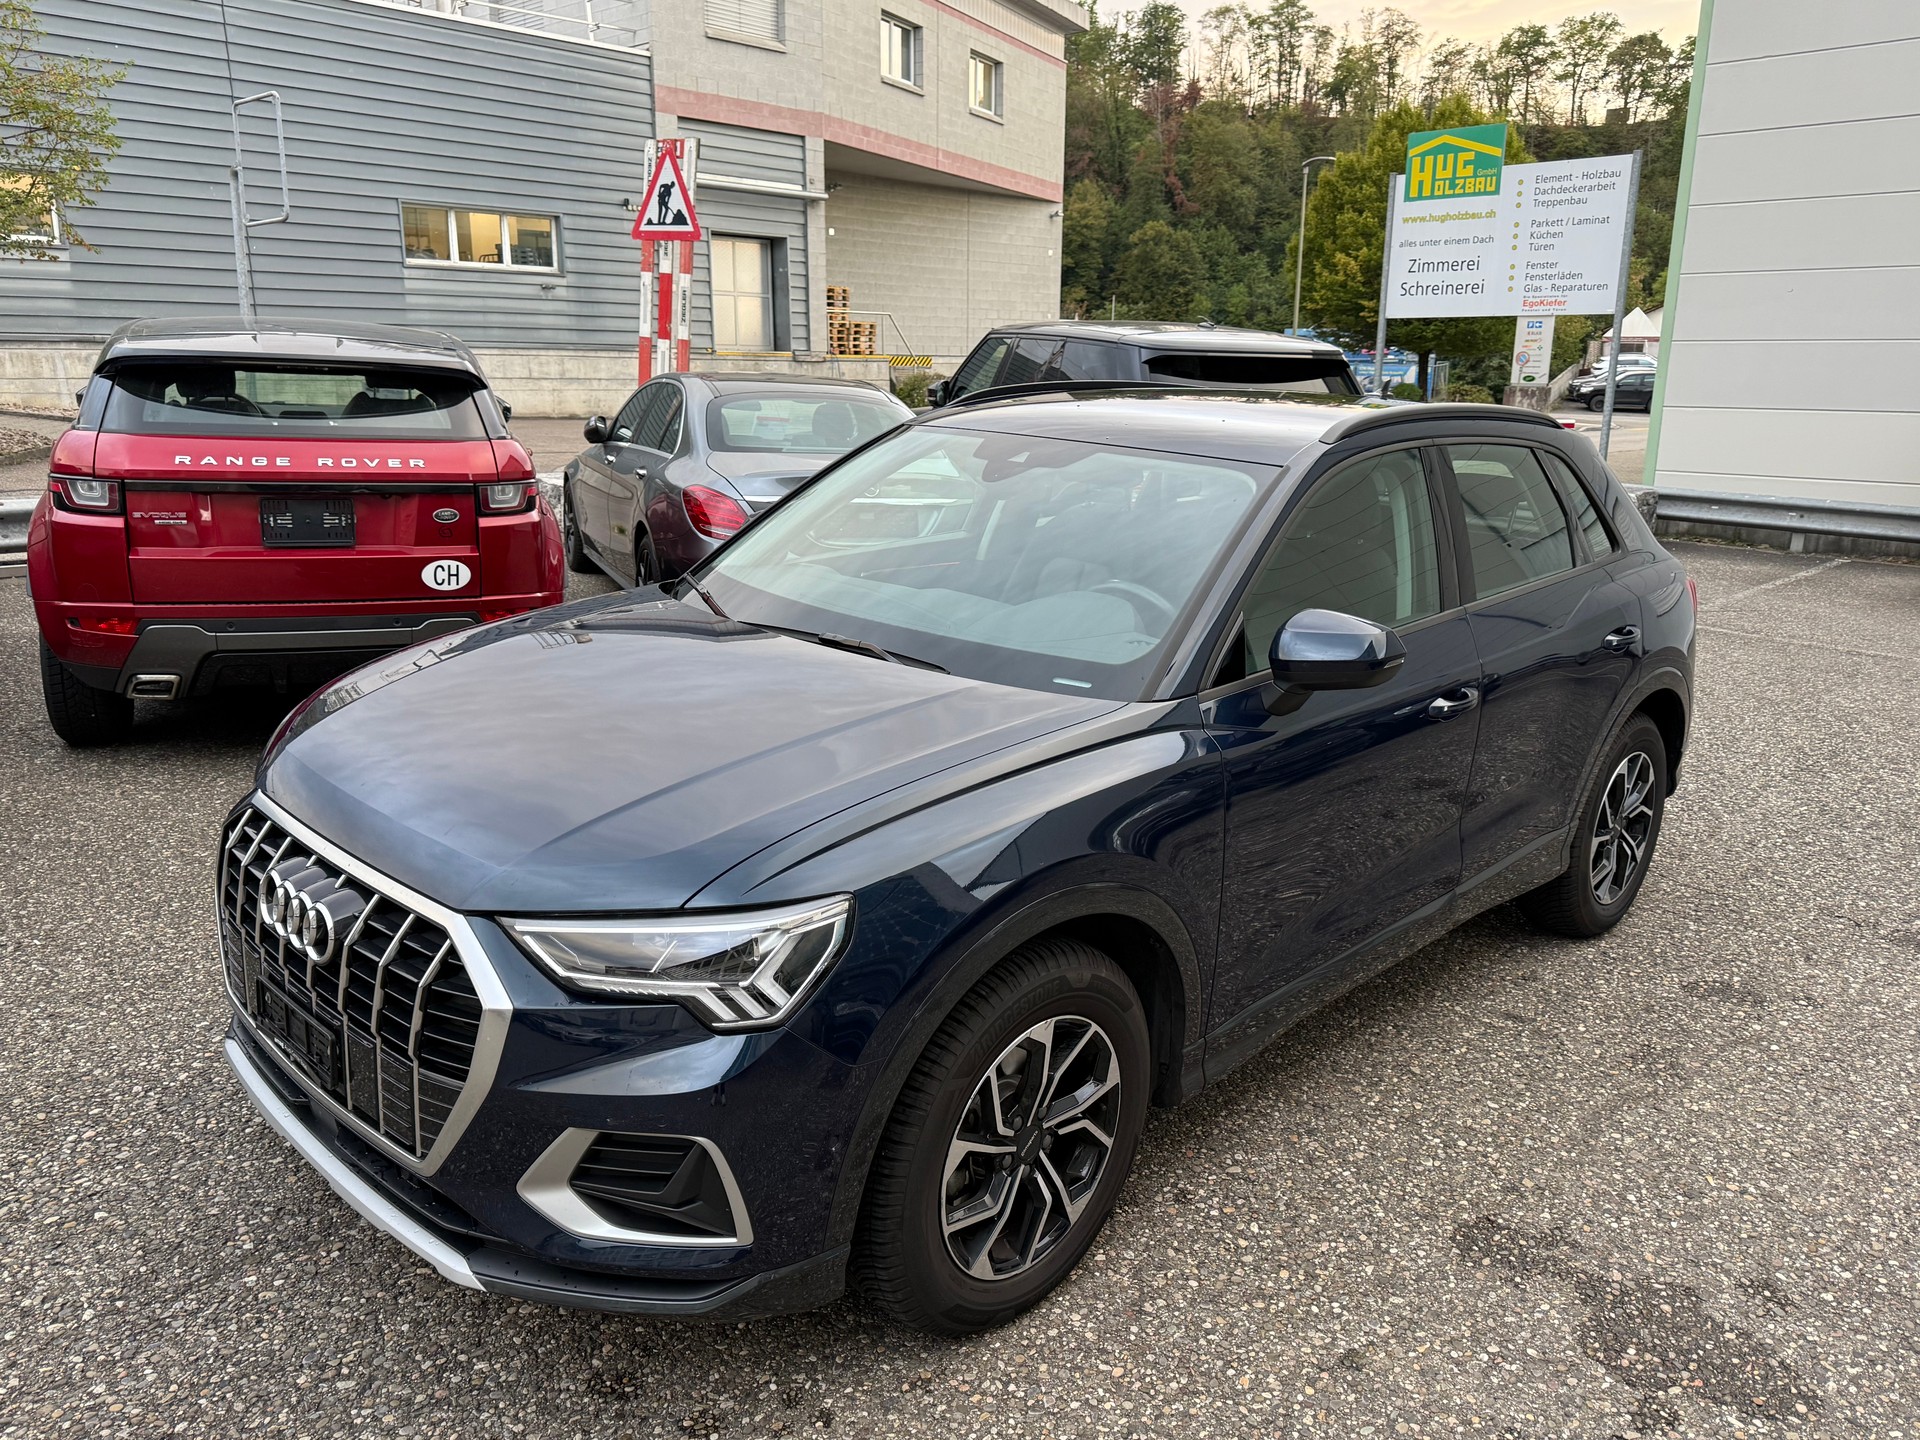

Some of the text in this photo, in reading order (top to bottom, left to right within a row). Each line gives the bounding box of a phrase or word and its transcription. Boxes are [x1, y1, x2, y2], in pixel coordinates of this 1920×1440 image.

[1476, 167, 1497, 176] GmbH
[1535, 173, 1573, 184] Element
[1581, 169, 1621, 180] Holzbau
[1534, 181, 1616, 196] Dachdeckerarbeit
[1533, 196, 1588, 208] Treppenbau
[1402, 209, 1496, 224] www.hugholzbau.ch
[1530, 218, 1564, 228] Parkett
[1571, 216, 1610, 226] Laminat
[1529, 230, 1564, 240] Küchen
[1399, 235, 1494, 248] alles unter einem Dach
[1528, 242, 1555, 252] Türen
[1408, 255, 1480, 273] Zimmerei
[1525, 261, 1559, 270] Fenster
[1524, 271, 1583, 281] Fensterläden
[1400, 279, 1485, 296] Schreinerei
[1523, 284, 1542, 293] Glas
[1550, 283, 1608, 293] Reparaturen
[1522, 298, 1567, 308] EgoKiefer
[174, 455, 426, 468] RANGE ROVER
[433, 564, 459, 586] CH
